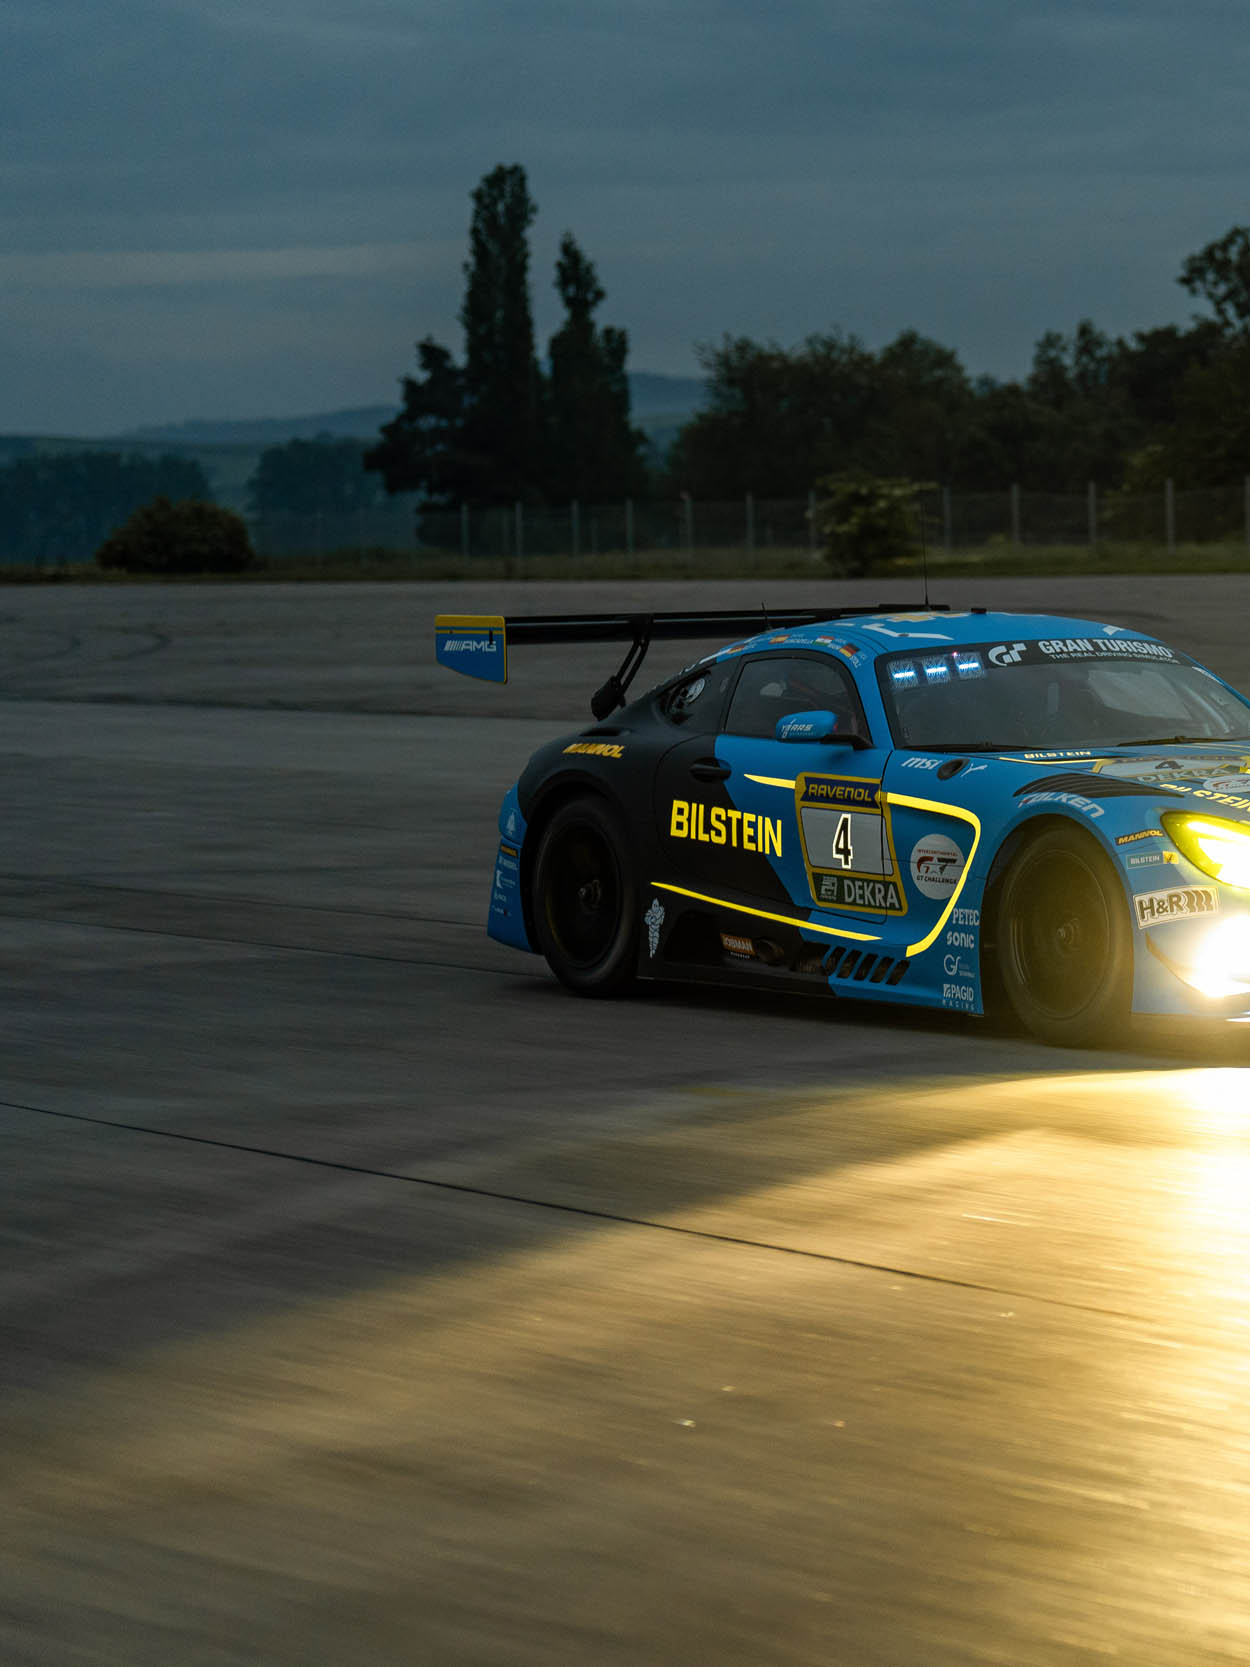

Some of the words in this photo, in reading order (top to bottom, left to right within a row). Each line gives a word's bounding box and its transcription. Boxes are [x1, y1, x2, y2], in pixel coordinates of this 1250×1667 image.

[462, 640, 497, 652] AMG
[1038, 639, 1094, 654] GRAN
[1093, 639, 1173, 658] TURISMO
[808, 784, 873, 802] RAVENOL
[670, 799, 783, 858] BILSTEIN
[1118, 830, 1164, 844] MANNOL
[832, 813, 854, 869] 4
[1130, 855, 1160, 865] BILSTEIN
[843, 879, 900, 909] DEKRA
[1138, 893, 1184, 920] H&R
[952, 908, 980, 926] PETEC
[951, 984, 974, 1001] PAGID
